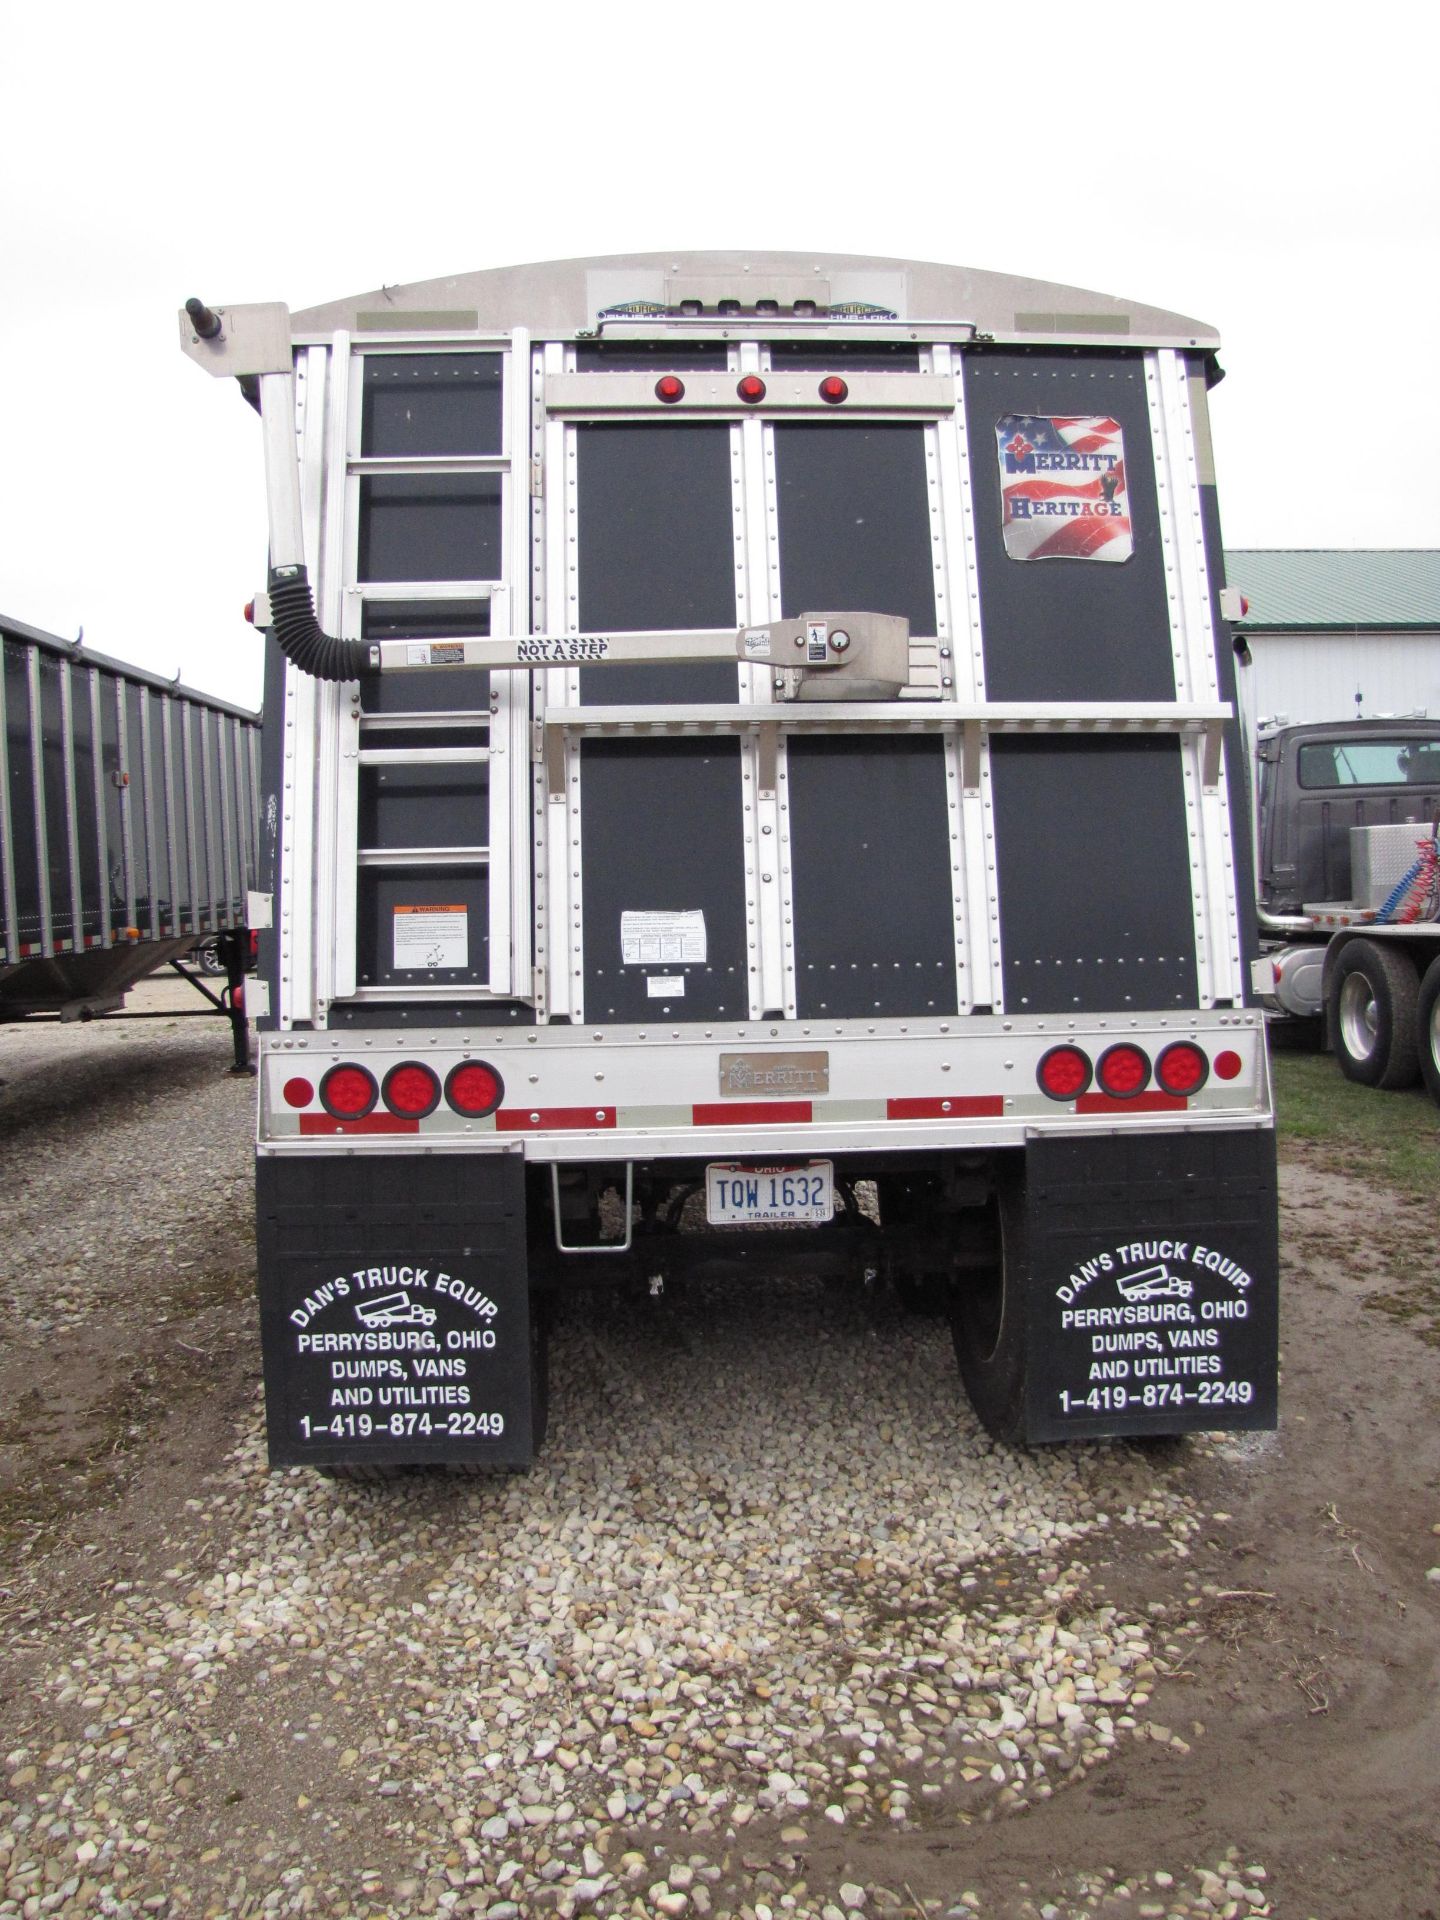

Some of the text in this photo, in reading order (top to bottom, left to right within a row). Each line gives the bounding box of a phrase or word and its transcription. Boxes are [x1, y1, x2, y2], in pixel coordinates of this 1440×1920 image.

[1005, 453, 1118, 474] MERRITT
[1009, 497, 1122, 519] HERITAGE
[517, 643, 608, 656] NOT A STEP
[728, 1069, 817, 1088] MERRITT
[716, 1177, 824, 1209] TQW 1632
[748, 1211, 795, 1219] TRAILER
[1056, 1240, 1251, 1304] DAN'S TRUCK EQUIP.
[290, 1266, 499, 1328] DAN'S TRUCK EQUIP.
[1061, 1299, 1248, 1329] PERRYSBURG, OHIO
[298, 1330, 496, 1352] PERRYSBURG, OHIO
[1091, 1328, 1219, 1352] DUMPS, VANS
[331, 1358, 467, 1381] DUMPS, VANS
[1089, 1355, 1221, 1380] AND UTILITIES
[331, 1385, 471, 1406] AND UTILITIES
[1059, 1381, 1252, 1412] 1-419-874-2249
[300, 1413, 505, 1438] 1-419-874-2249
